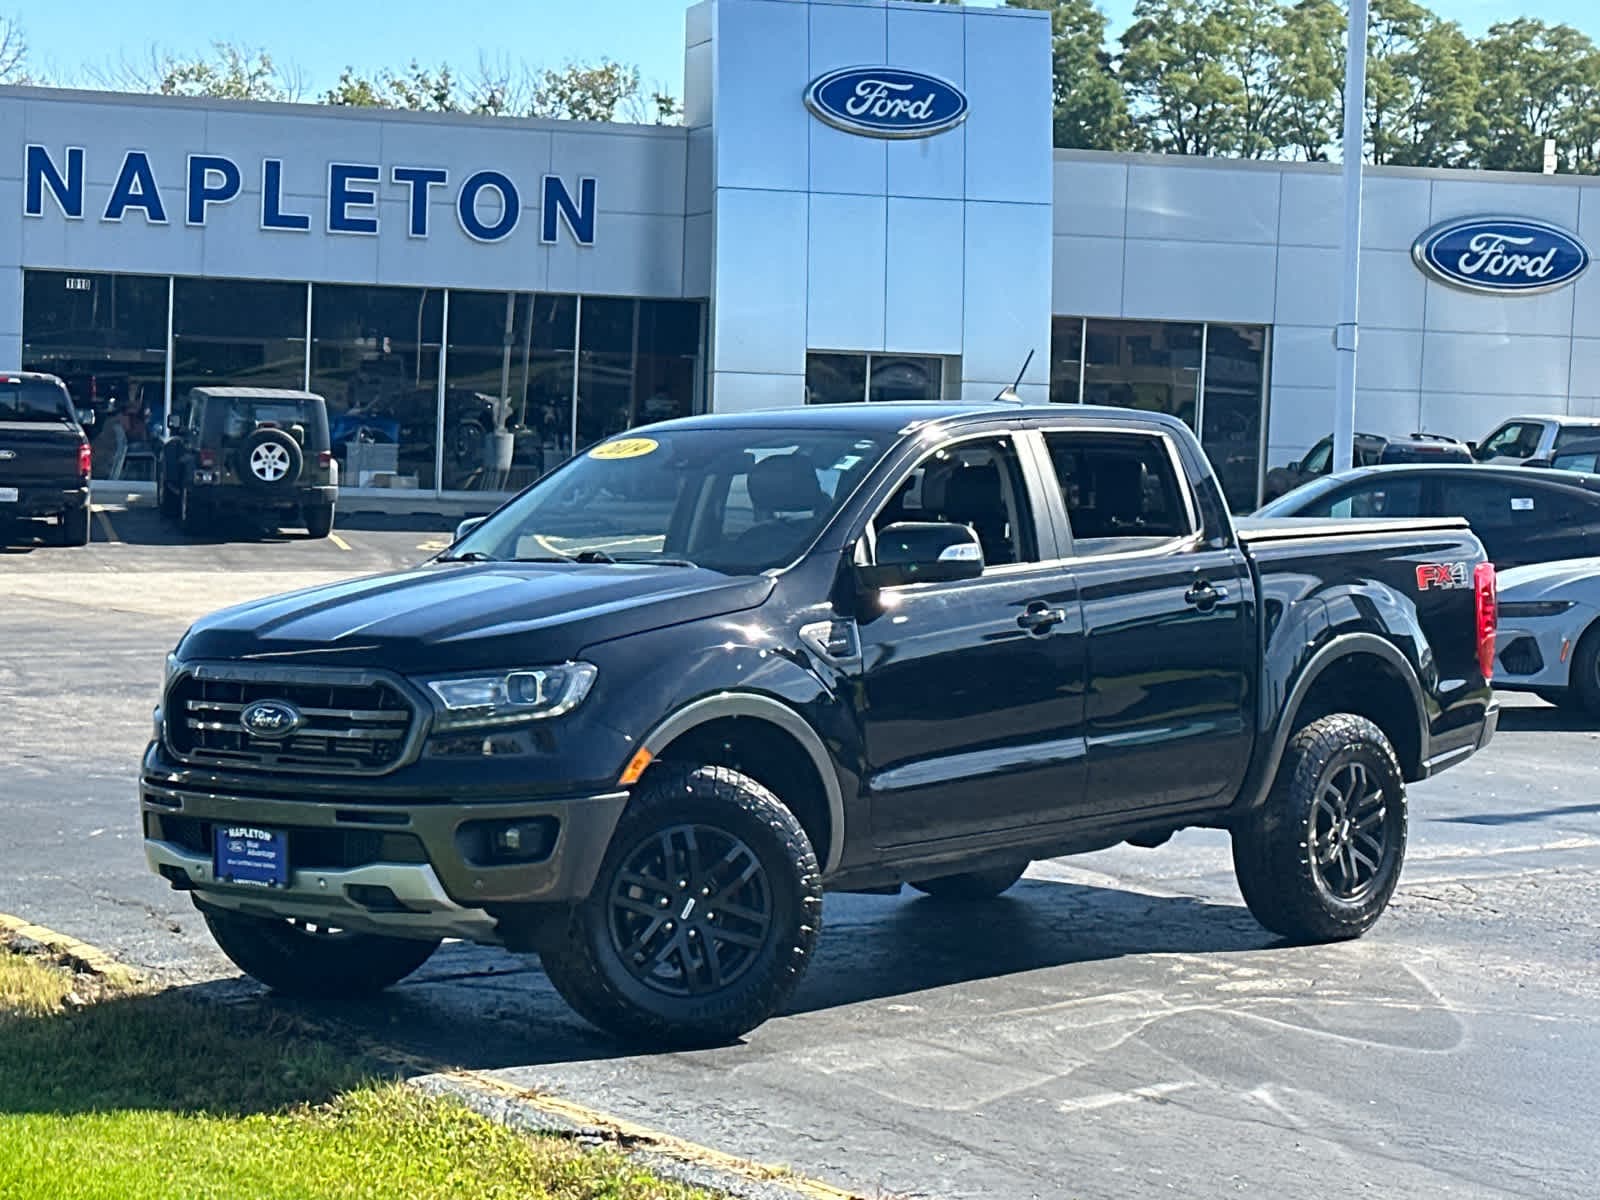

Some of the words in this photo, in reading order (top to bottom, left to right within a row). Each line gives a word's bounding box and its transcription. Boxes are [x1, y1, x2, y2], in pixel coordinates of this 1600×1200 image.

[845, 79, 936, 119] Ford
[23, 143, 597, 247] NAPLETON
[1458, 232, 1558, 278] Ford
[1416, 562, 1469, 591] FX4
[251, 707, 282, 728] Ford
[228, 827, 272, 841] NAPLETON
